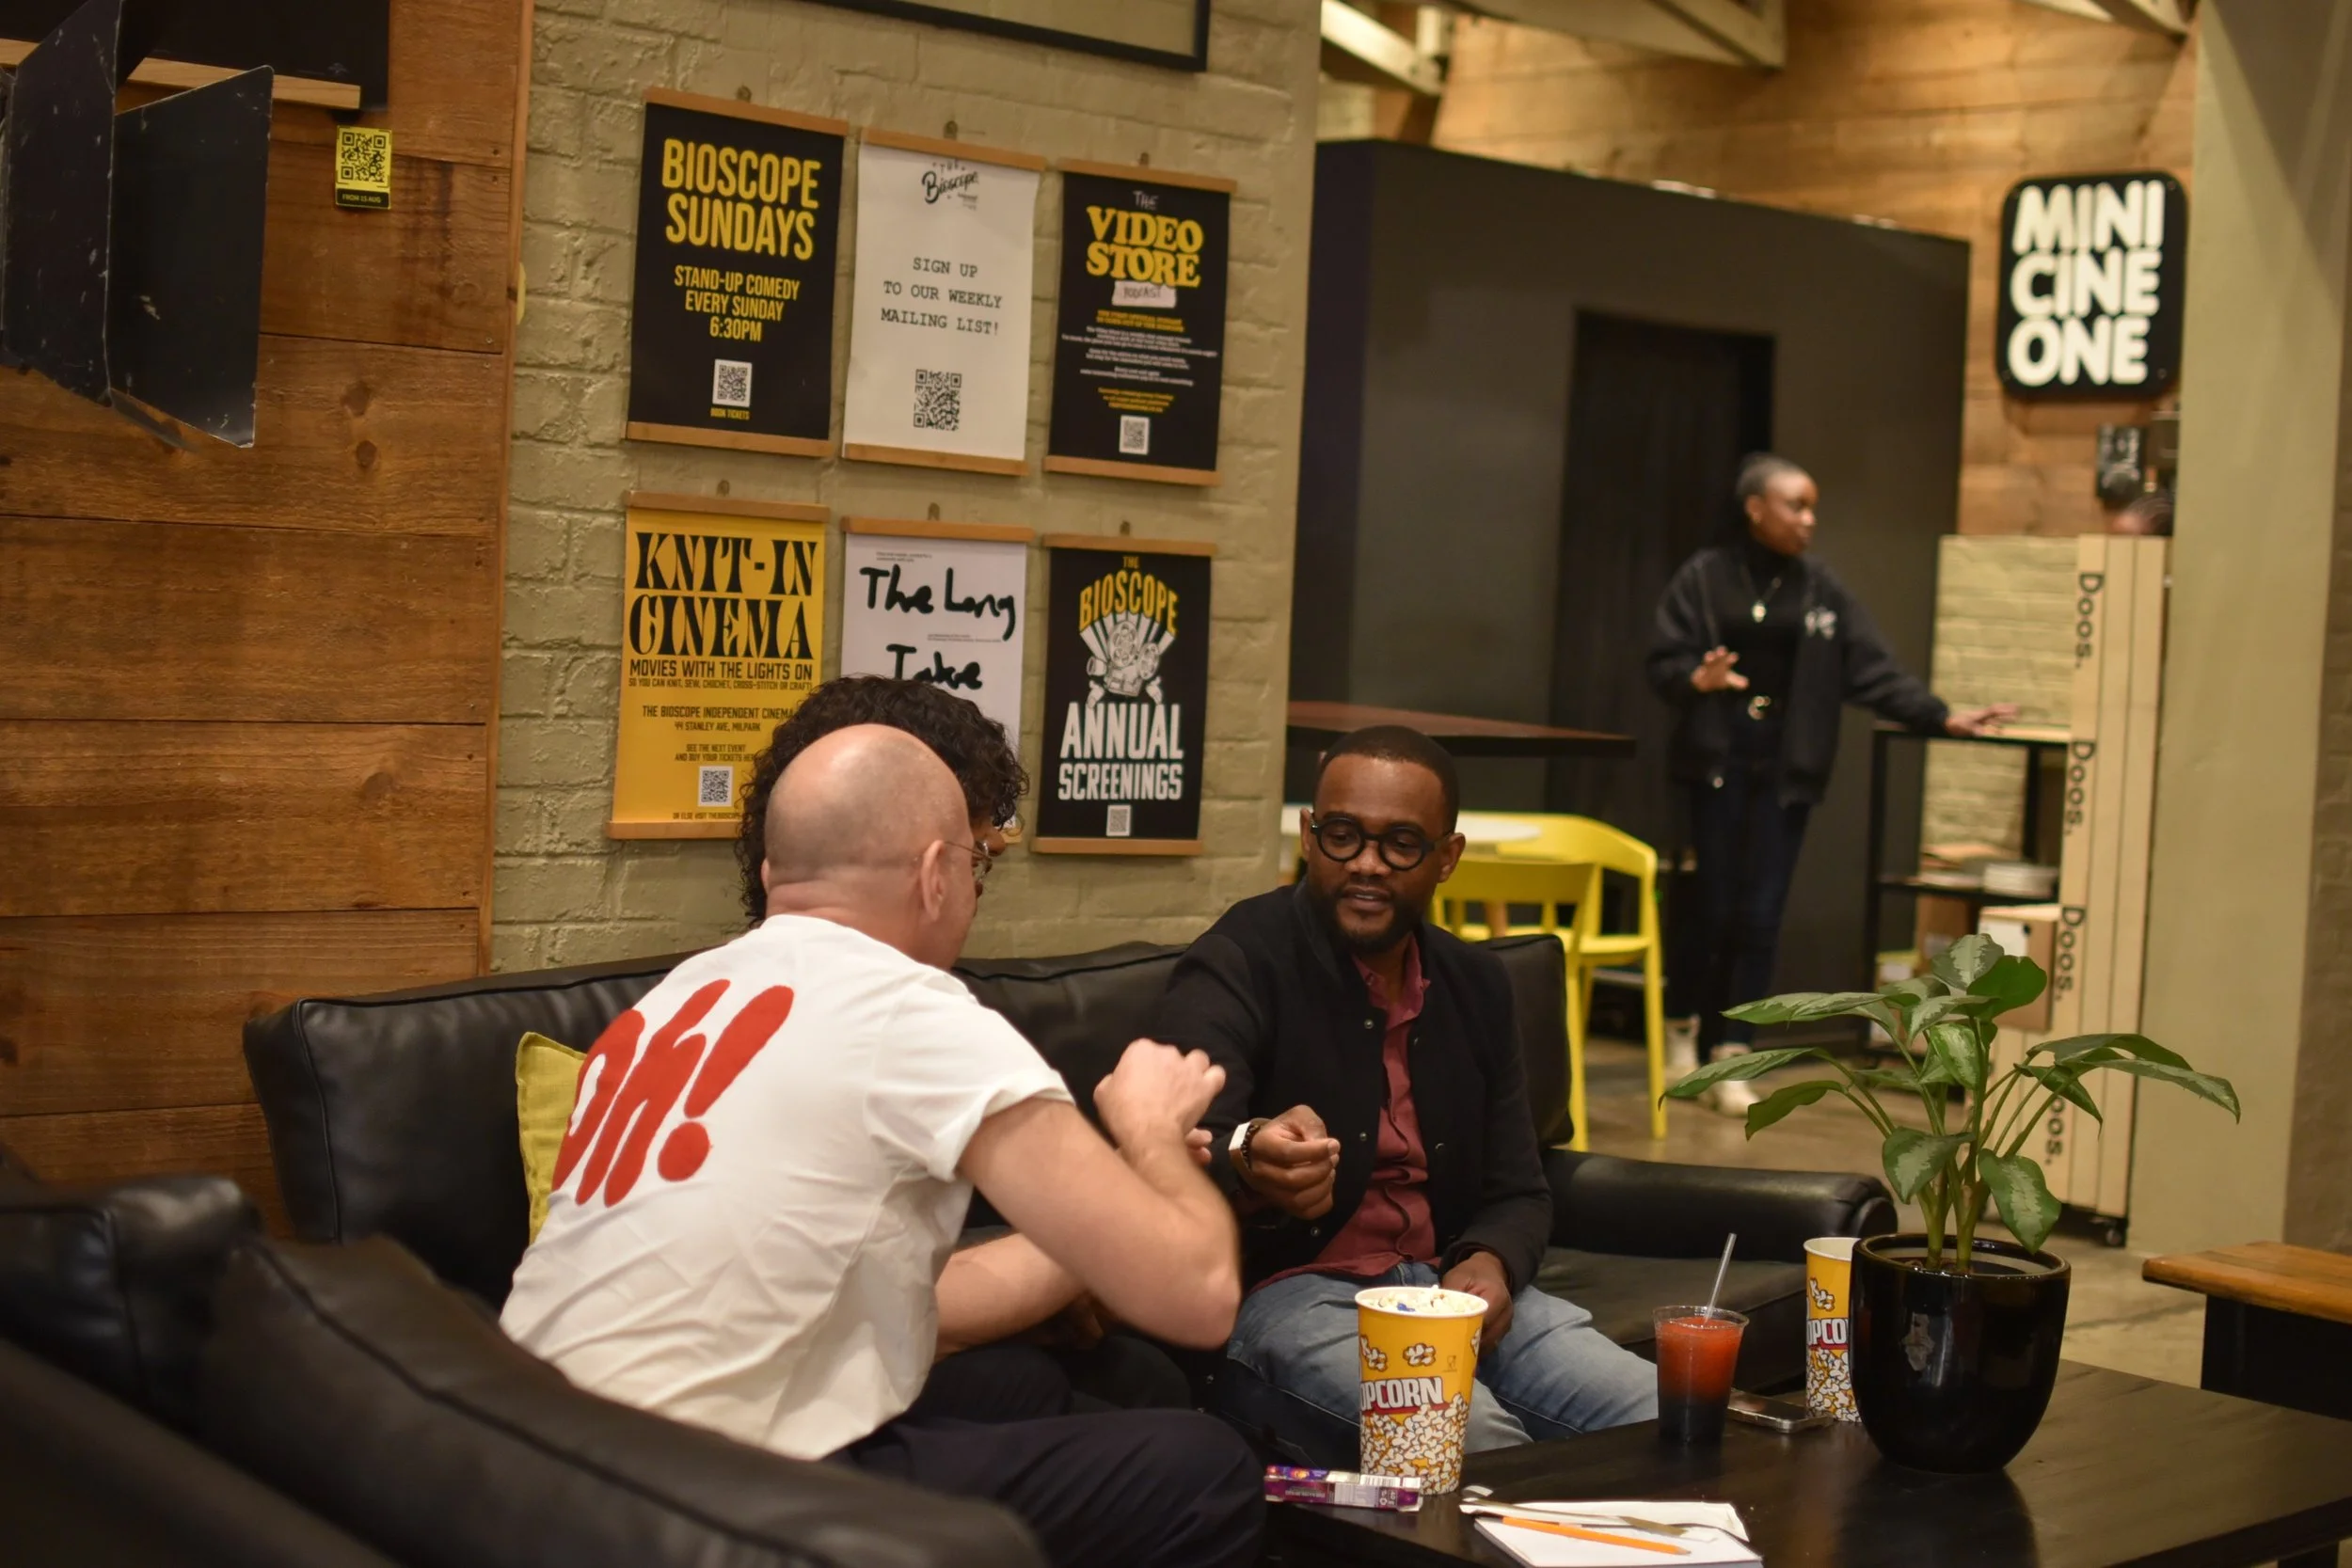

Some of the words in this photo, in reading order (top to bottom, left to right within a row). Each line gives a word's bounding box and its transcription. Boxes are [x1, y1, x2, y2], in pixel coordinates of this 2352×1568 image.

[661, 138, 821, 209] BIOSCOPE
[921, 170, 978, 204] Bioscope
[665, 193, 815, 261] SUNDAYS
[1086, 205, 1203, 253] VIDEO
[2011, 180, 2165, 255] MINI
[675, 264, 743, 293] STAND-UP
[746, 274, 800, 300] COMEDY
[913, 257, 950, 274] SIGN
[960, 263, 977, 277] UP
[1086, 241, 1201, 288] STORE
[2010, 245, 2163, 319] CINE
[685, 290, 729, 314] EVERY
[732, 295, 784, 321] SUNDAY
[883, 281, 901, 294] TO
[911, 285, 940, 300] OUR
[948, 290, 1002, 309] WEEKLY
[1123, 286, 1162, 299] PODCAST
[709, 316, 762, 342] 6:30PM
[881, 308, 947, 328] MAILING
[957, 318, 998, 335] LIST!
[2008, 313, 2151, 387] ONE
[727, 409, 751, 420] TICKETS
[634, 531, 818, 596] KNIT-IN
[860, 564, 934, 614] The
[945, 567, 1016, 641] Long
[1079, 569, 1178, 637] BIOSCOPE
[629, 594, 813, 659] CINEMA
[629, 659, 676, 676] MOVIES
[682, 660, 715, 677] WITH
[720, 661, 742, 678] THE
[747, 662, 790, 680] LIGHTS
[795, 663, 813, 681] ON
[886, 643, 983, 689] Take
[643, 705, 658, 717] THE
[660, 705, 701, 718] BIOSCOPE
[703, 706, 759, 720] INDEPENDENT
[762, 707, 794, 720] CINEMA
[685, 721, 714, 731] STANLEY
[732, 722, 761, 731] MILPARK
[1059, 701, 1184, 760] ANNUAL
[675, 752, 688, 761] AND
[686, 744, 697, 752] SEE
[698, 744, 709, 752] THE
[711, 744, 726, 752] NEXT
[727, 744, 746, 752] EVENT
[1057, 762, 1183, 800] SCREENINGS
[1360, 1376, 1444, 1411] OPCORN
